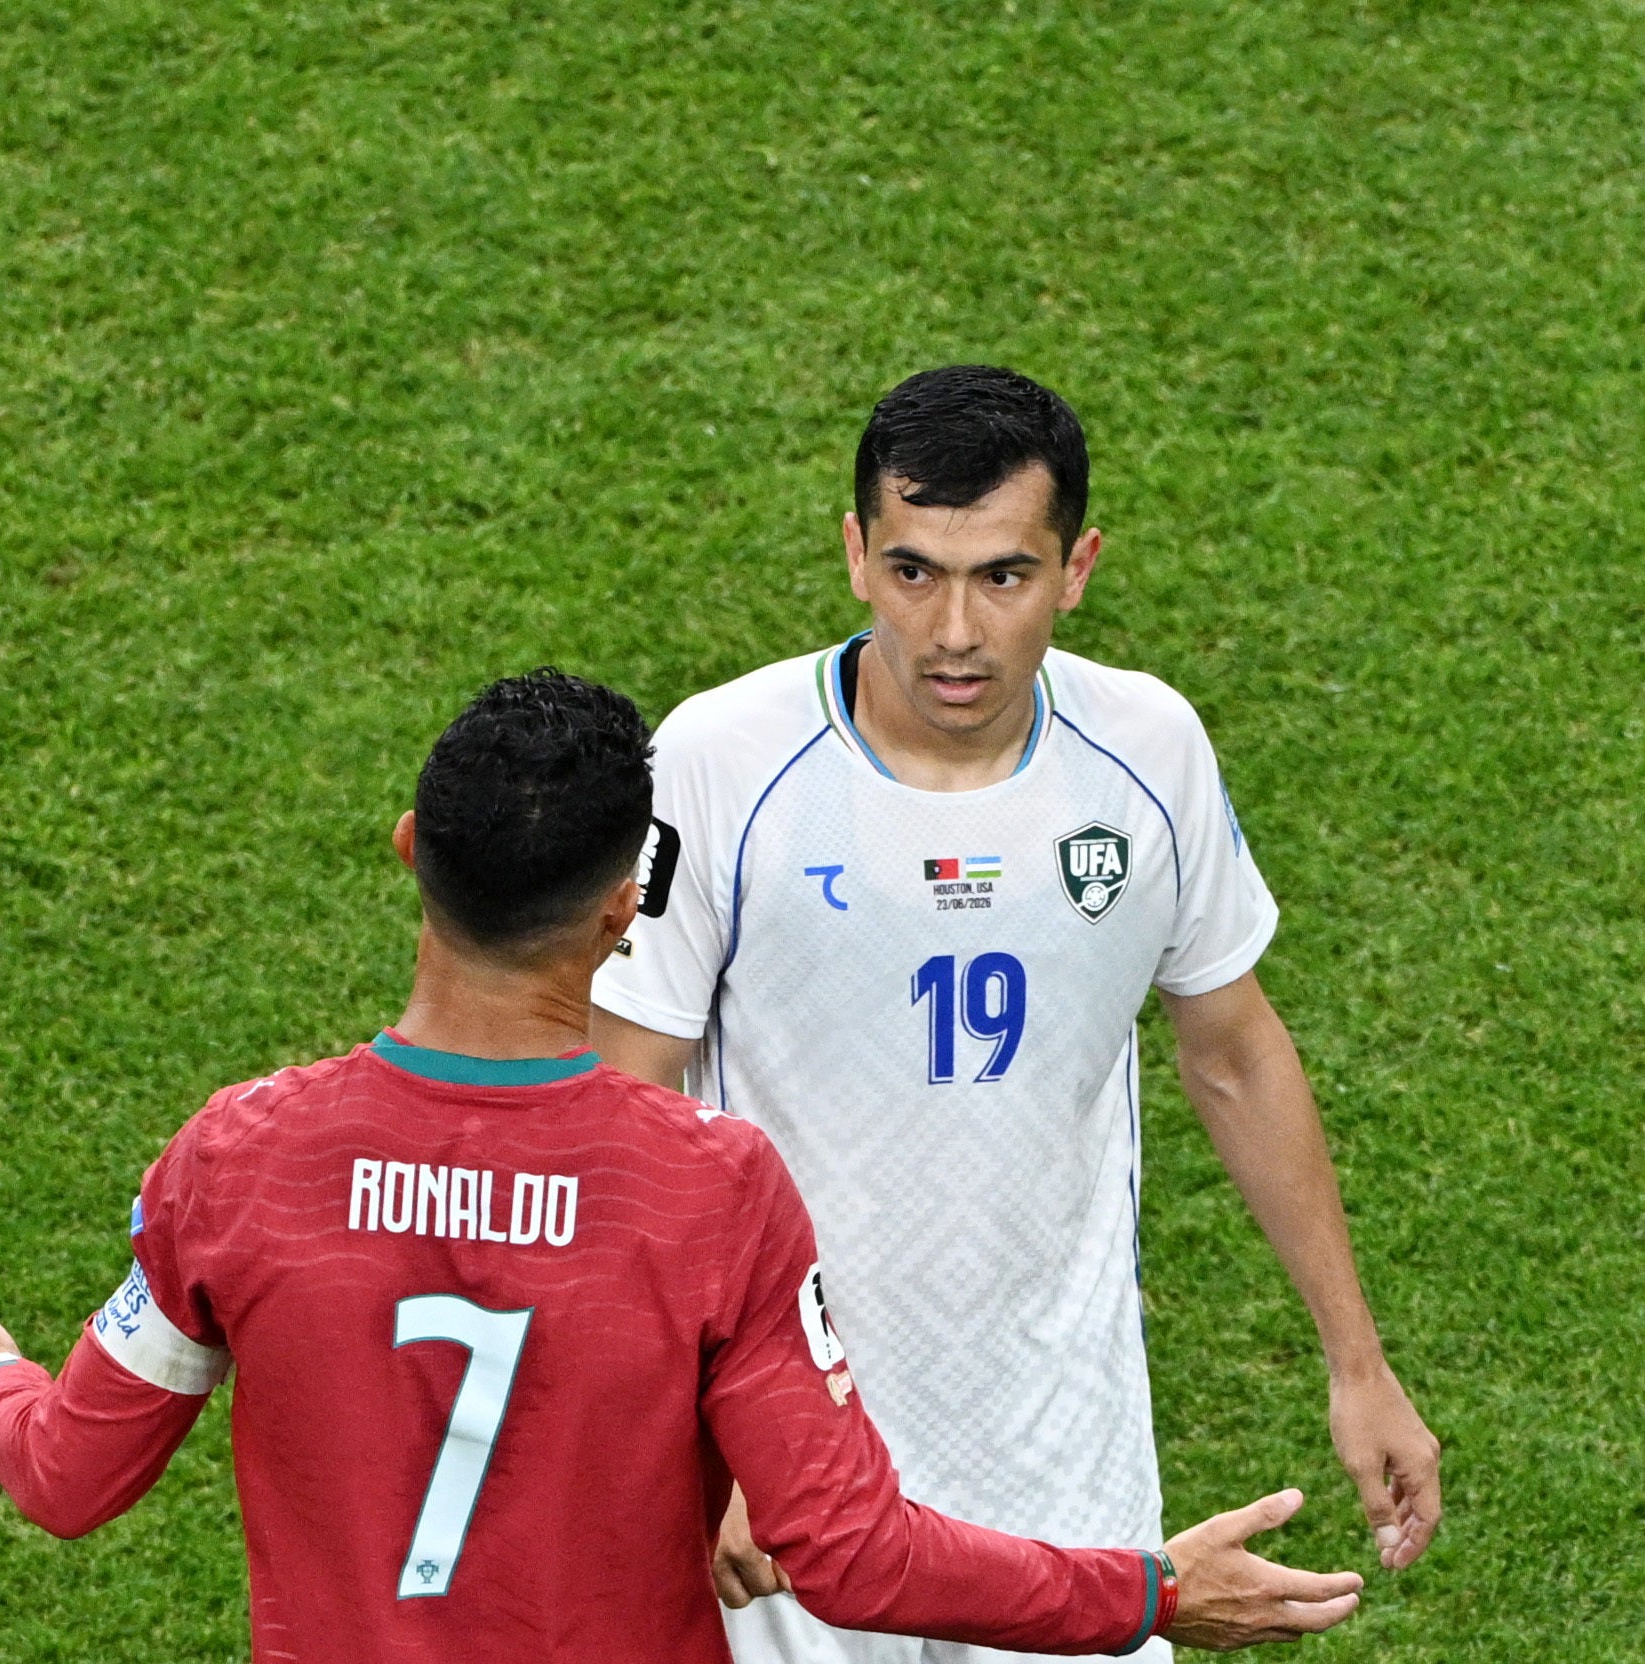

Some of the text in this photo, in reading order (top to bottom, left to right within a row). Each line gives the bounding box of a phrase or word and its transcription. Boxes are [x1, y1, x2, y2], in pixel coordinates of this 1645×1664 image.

[933, 882, 993, 895] HOUSTON, USA
[1069, 843, 1123, 877] UFA
[936, 897, 992, 911] 23/06/2026
[911, 951, 1027, 1085] 19
[348, 1158, 579, 1247] RONALDO
[392, 1293, 535, 1601] 7
